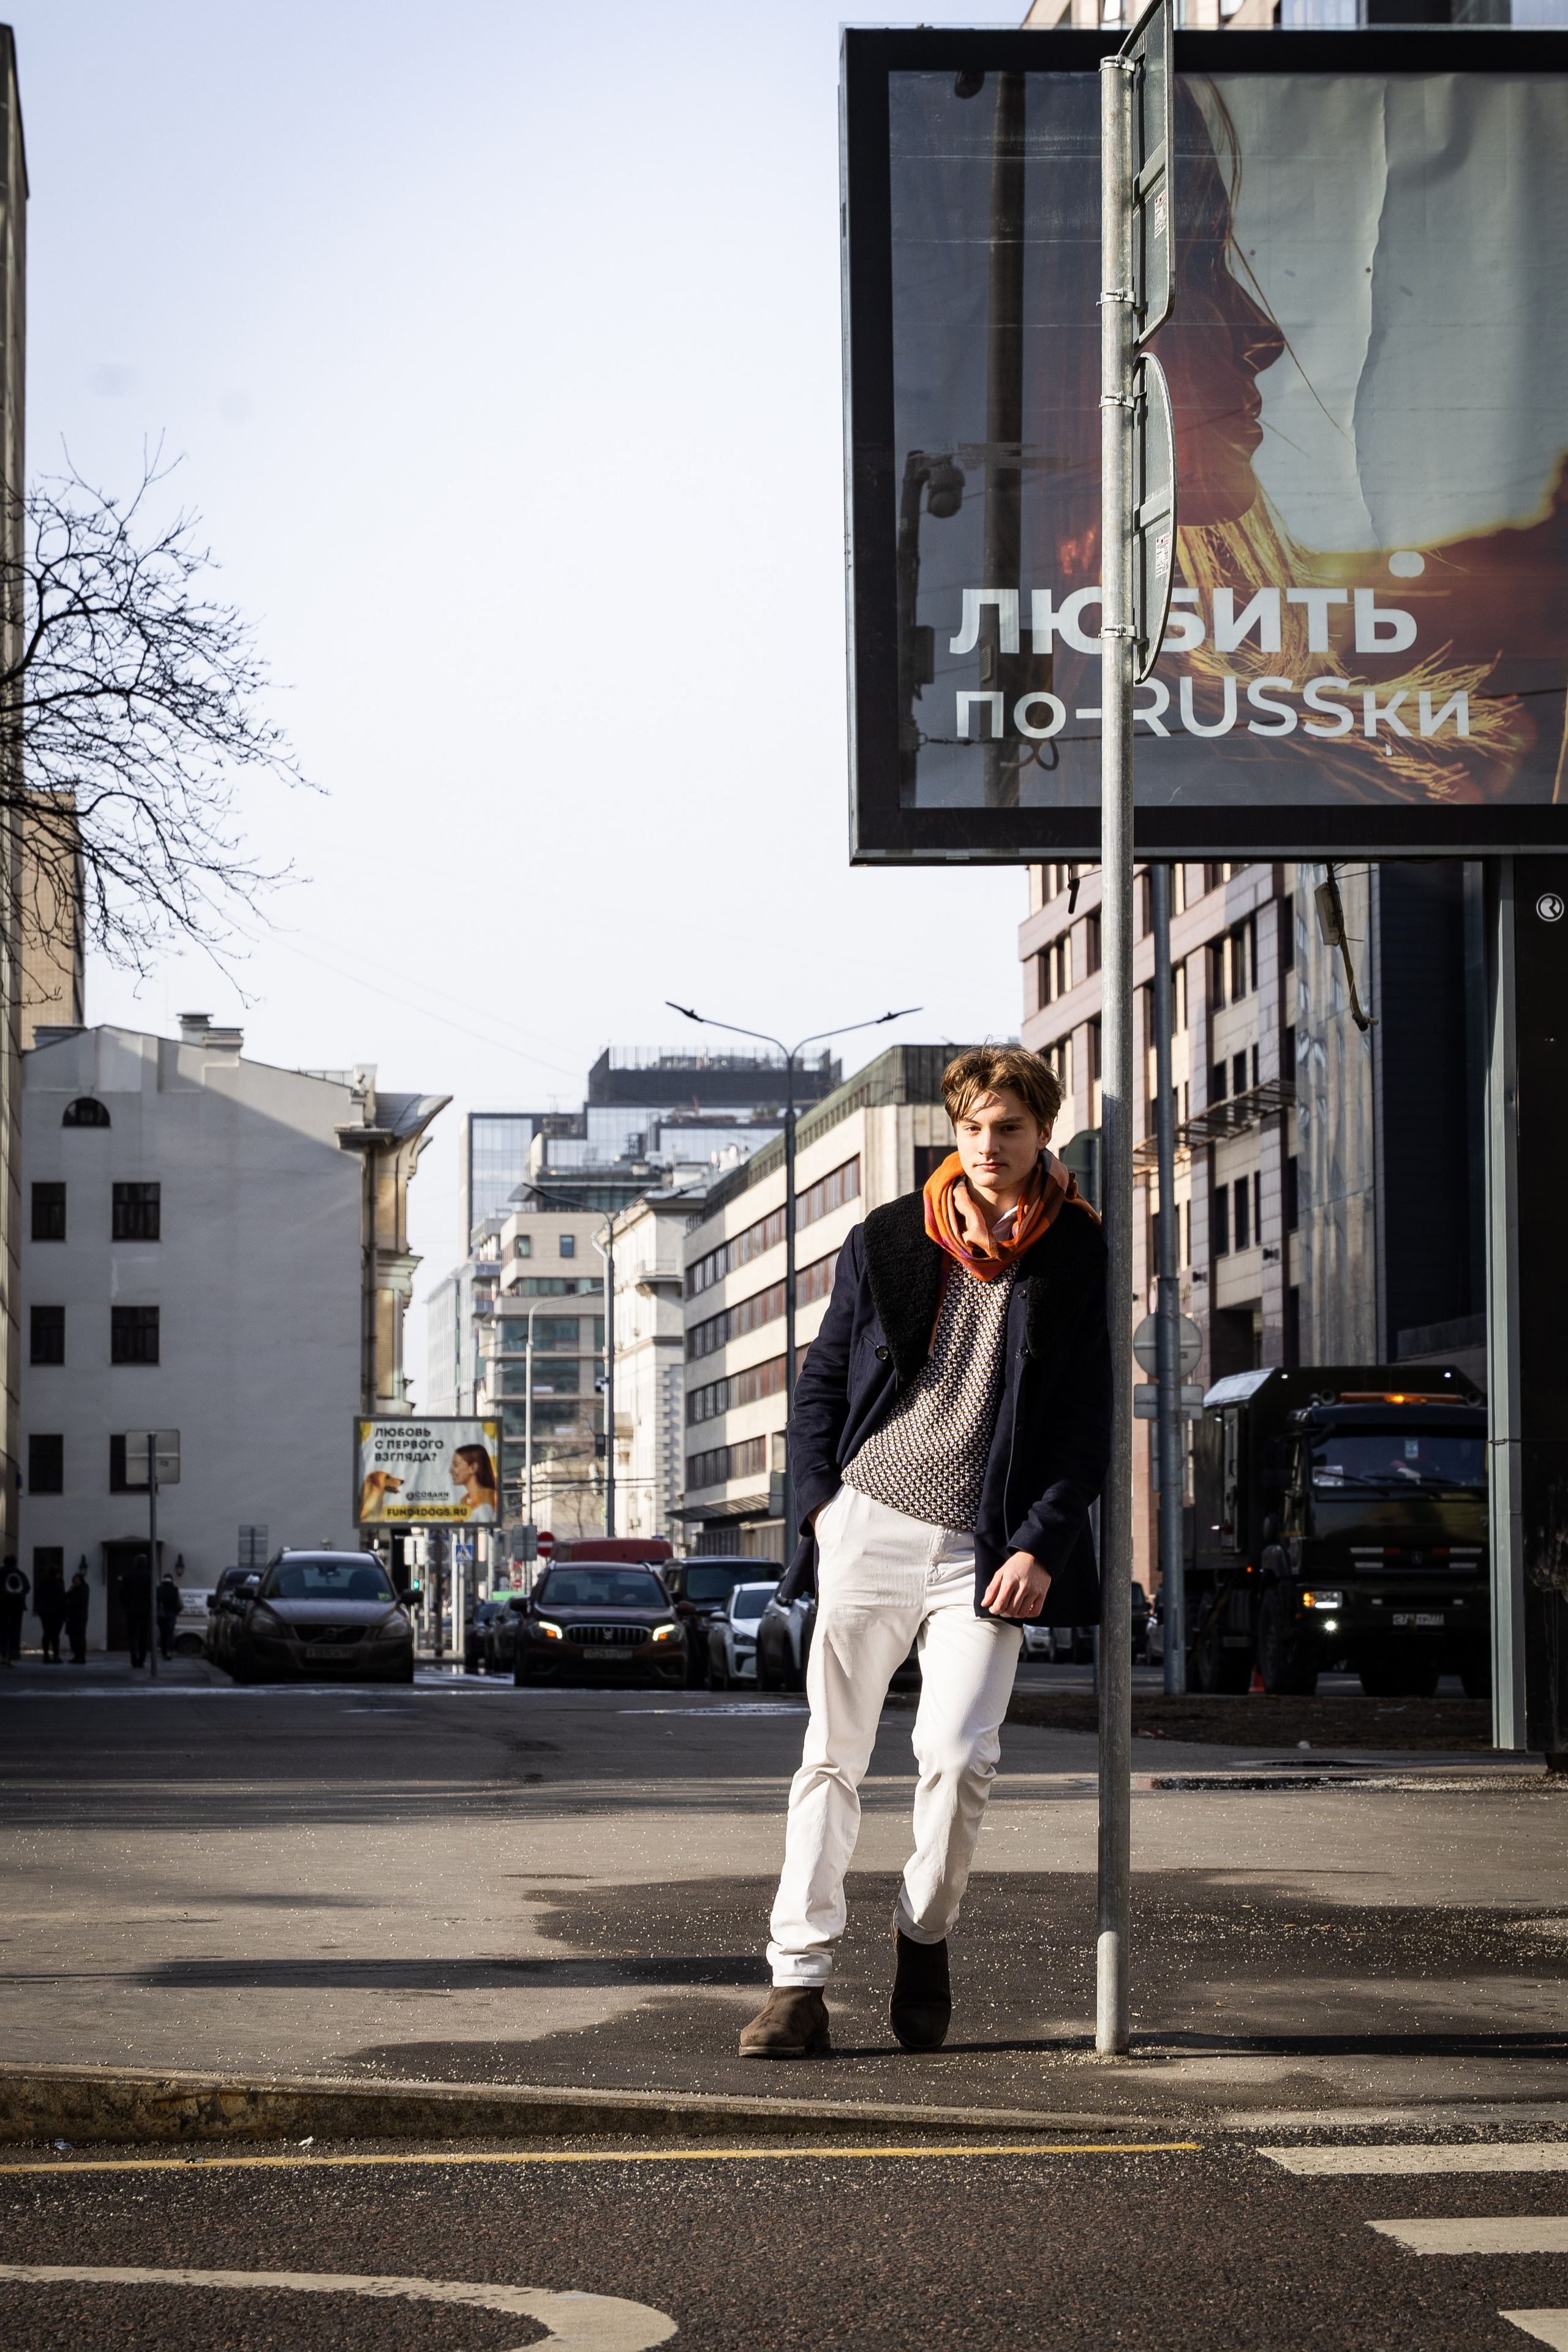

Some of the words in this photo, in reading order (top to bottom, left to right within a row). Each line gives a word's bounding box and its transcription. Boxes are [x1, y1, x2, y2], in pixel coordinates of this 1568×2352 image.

[949, 586, 1418, 655] ЛЮБИТЬ
[374, 1428, 431, 1437] ЛЮБОВЬ
[375, 1440, 383, 1449] С
[386, 1440, 444, 1449] ПЕРВОГО
[375, 1452, 437, 1463] ВЗГЛЯДА?
[386, 1508, 467, 1517] FUND4DOGS.RU
